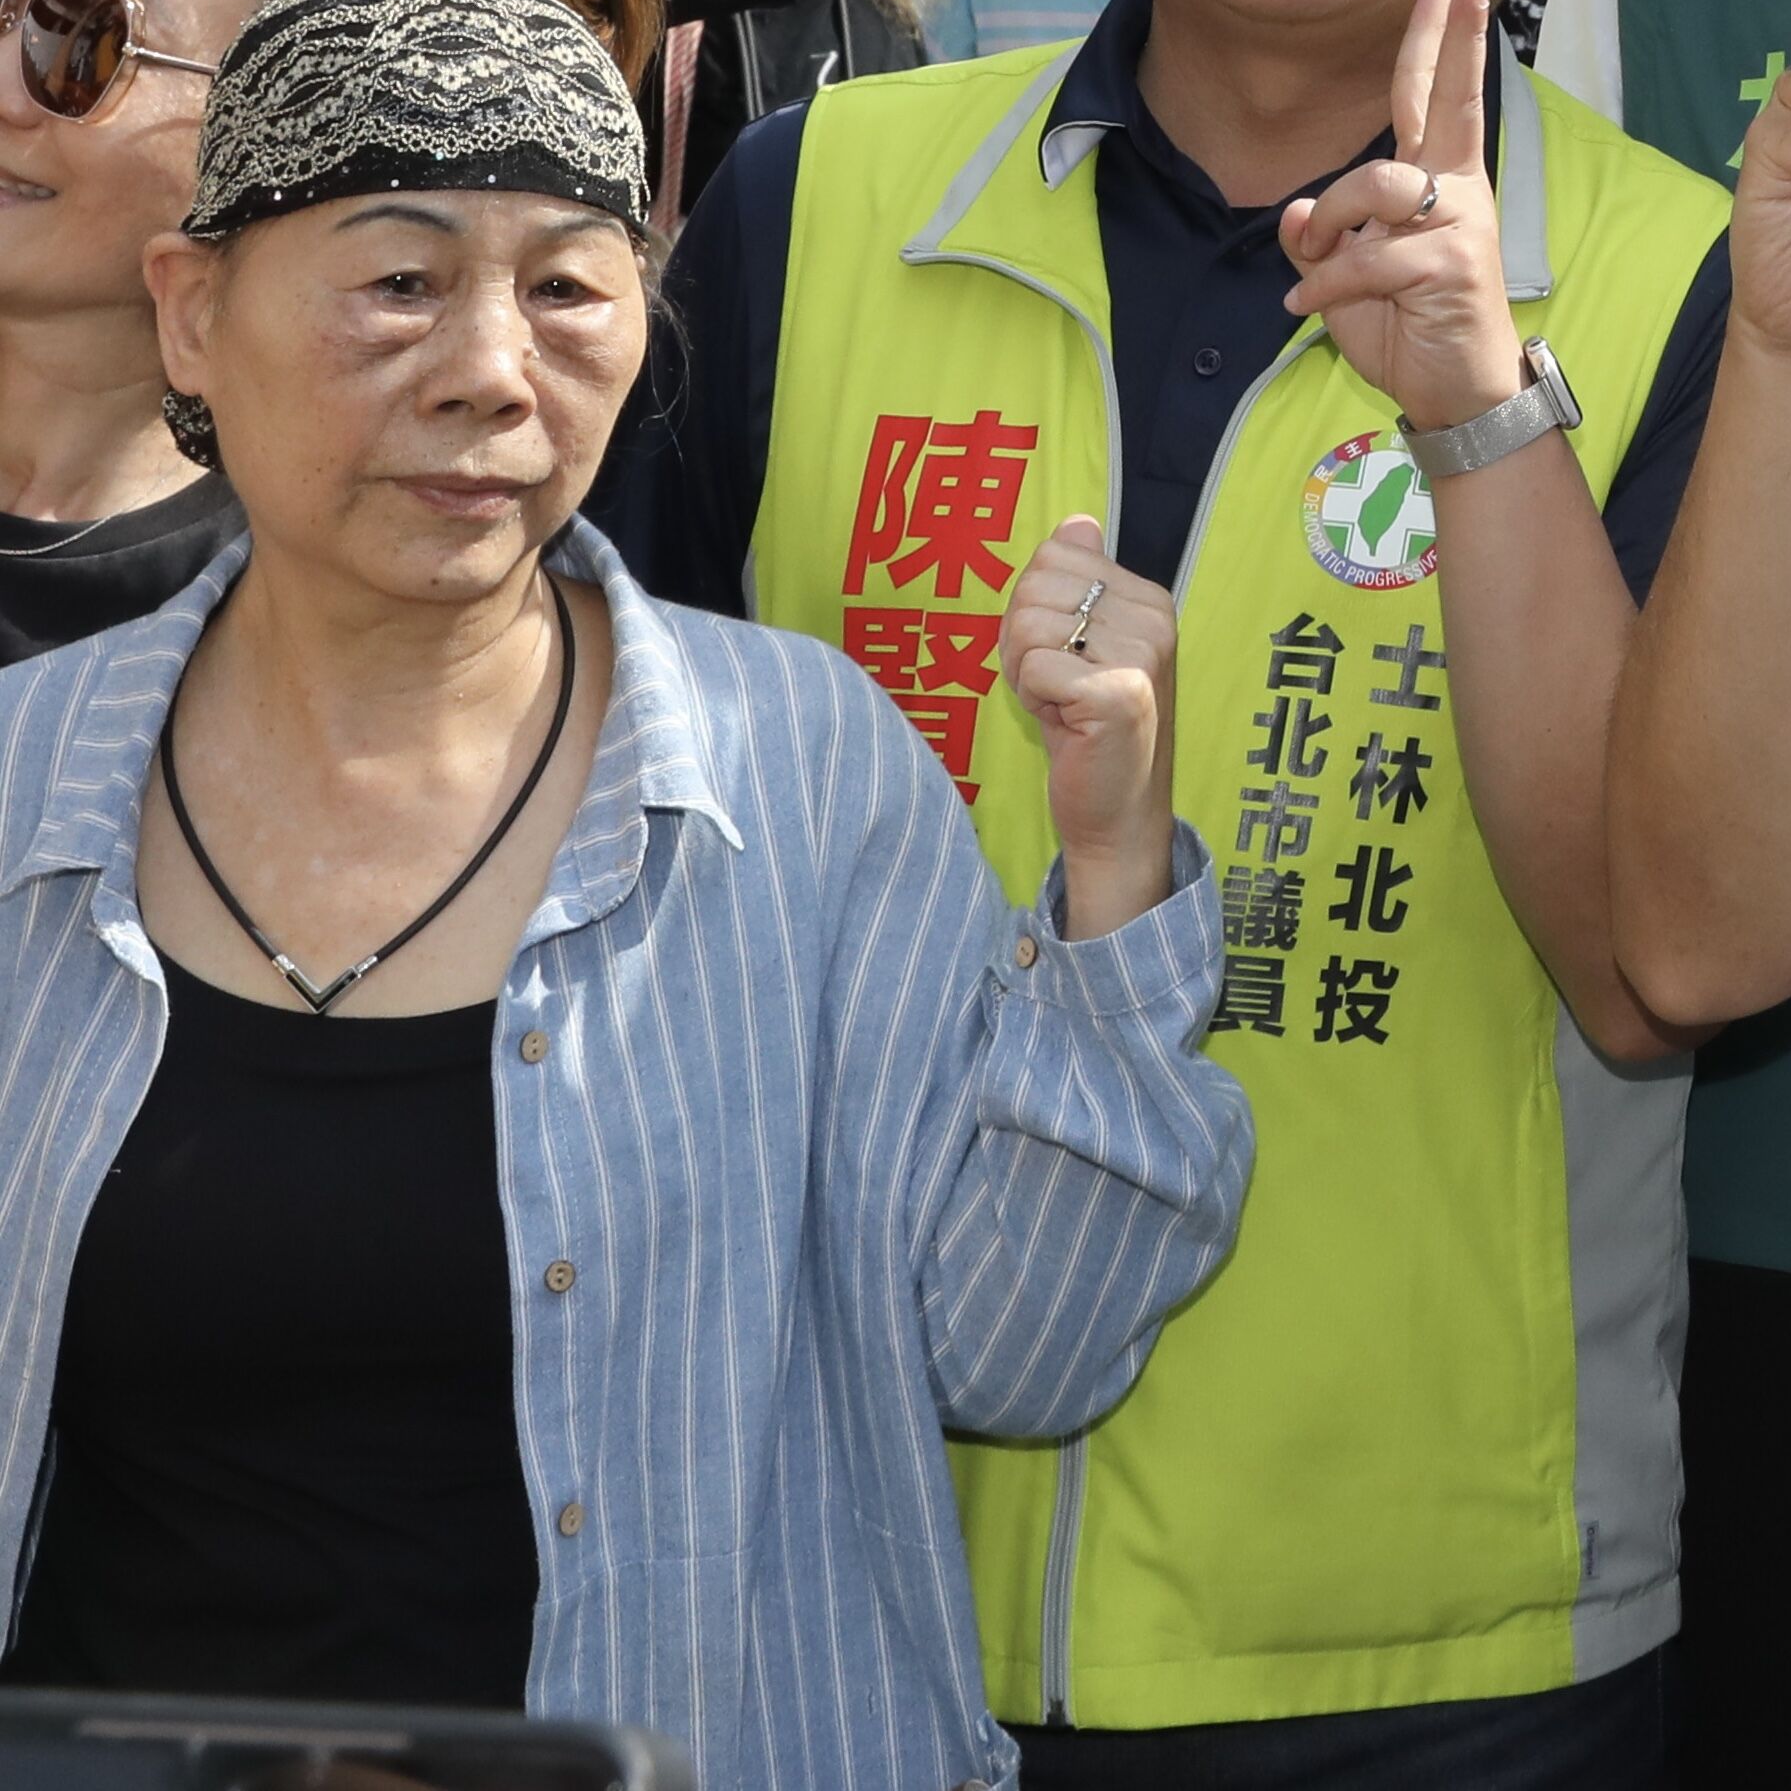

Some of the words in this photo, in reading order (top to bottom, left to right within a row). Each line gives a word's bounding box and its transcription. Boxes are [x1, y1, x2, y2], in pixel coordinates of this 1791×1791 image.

[1303, 492, 1346, 574] DEMOCRATIC
[1207, 612, 1346, 1038] 台北市議員
[1313, 624, 1448, 1046] 士林北投
